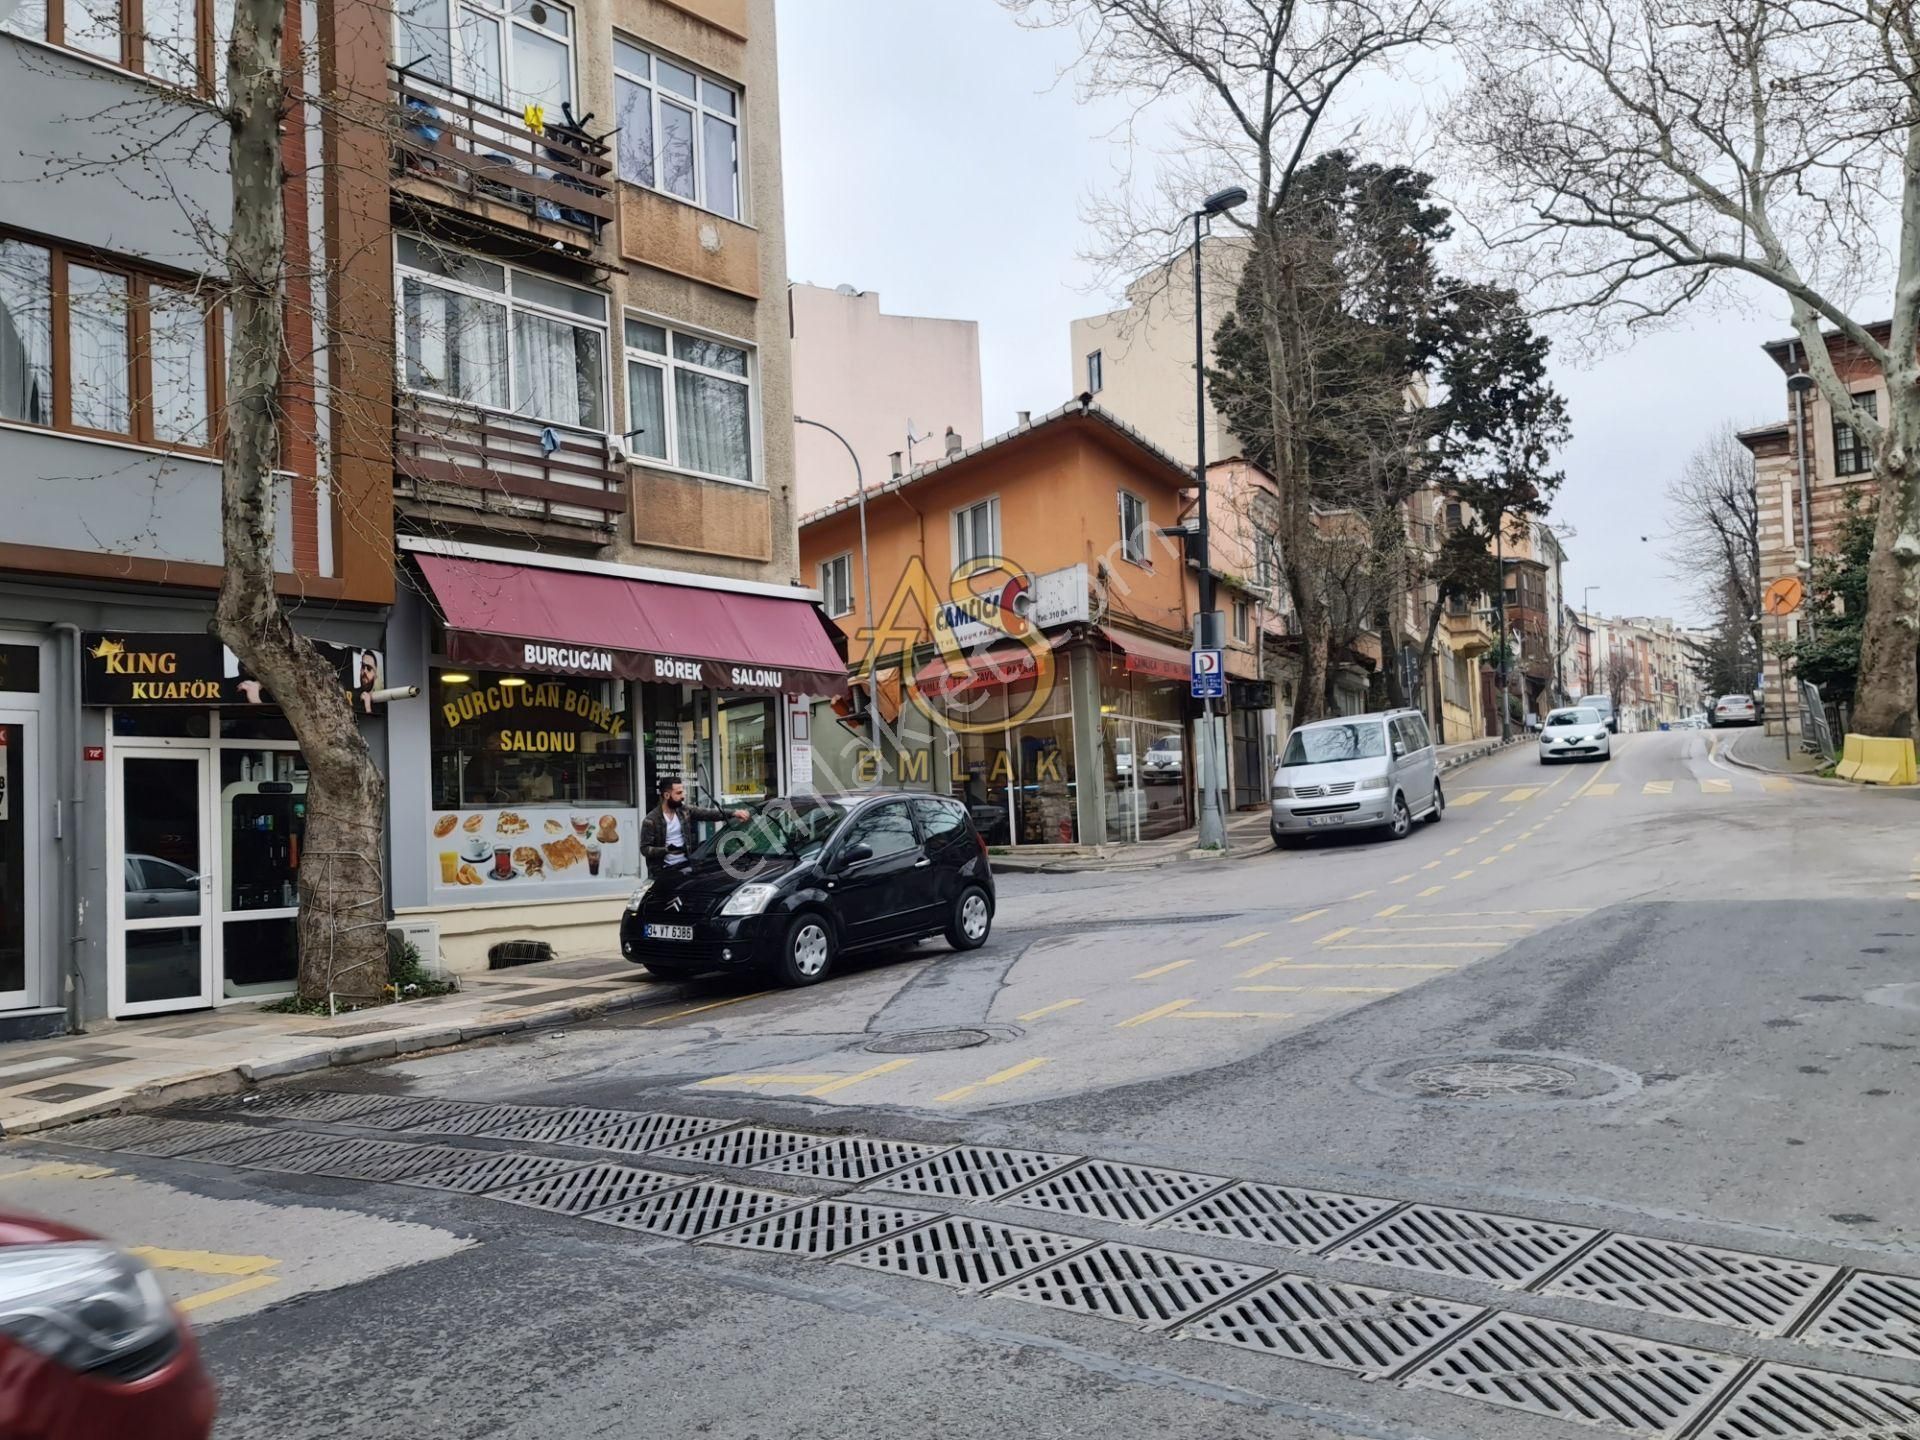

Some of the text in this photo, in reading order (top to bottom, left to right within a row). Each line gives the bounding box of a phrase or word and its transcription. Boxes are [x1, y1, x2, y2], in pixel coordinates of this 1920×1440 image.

[105, 652, 177, 674] KING
[524, 643, 782, 688] BURCUCAN BÖREK SALONU
[131, 679, 222, 699] KUAFÖR
[442, 684, 626, 739] BURCU CAN BÖREK
[500, 729, 575, 752] SALONU
[648, 925, 657, 937] 34
